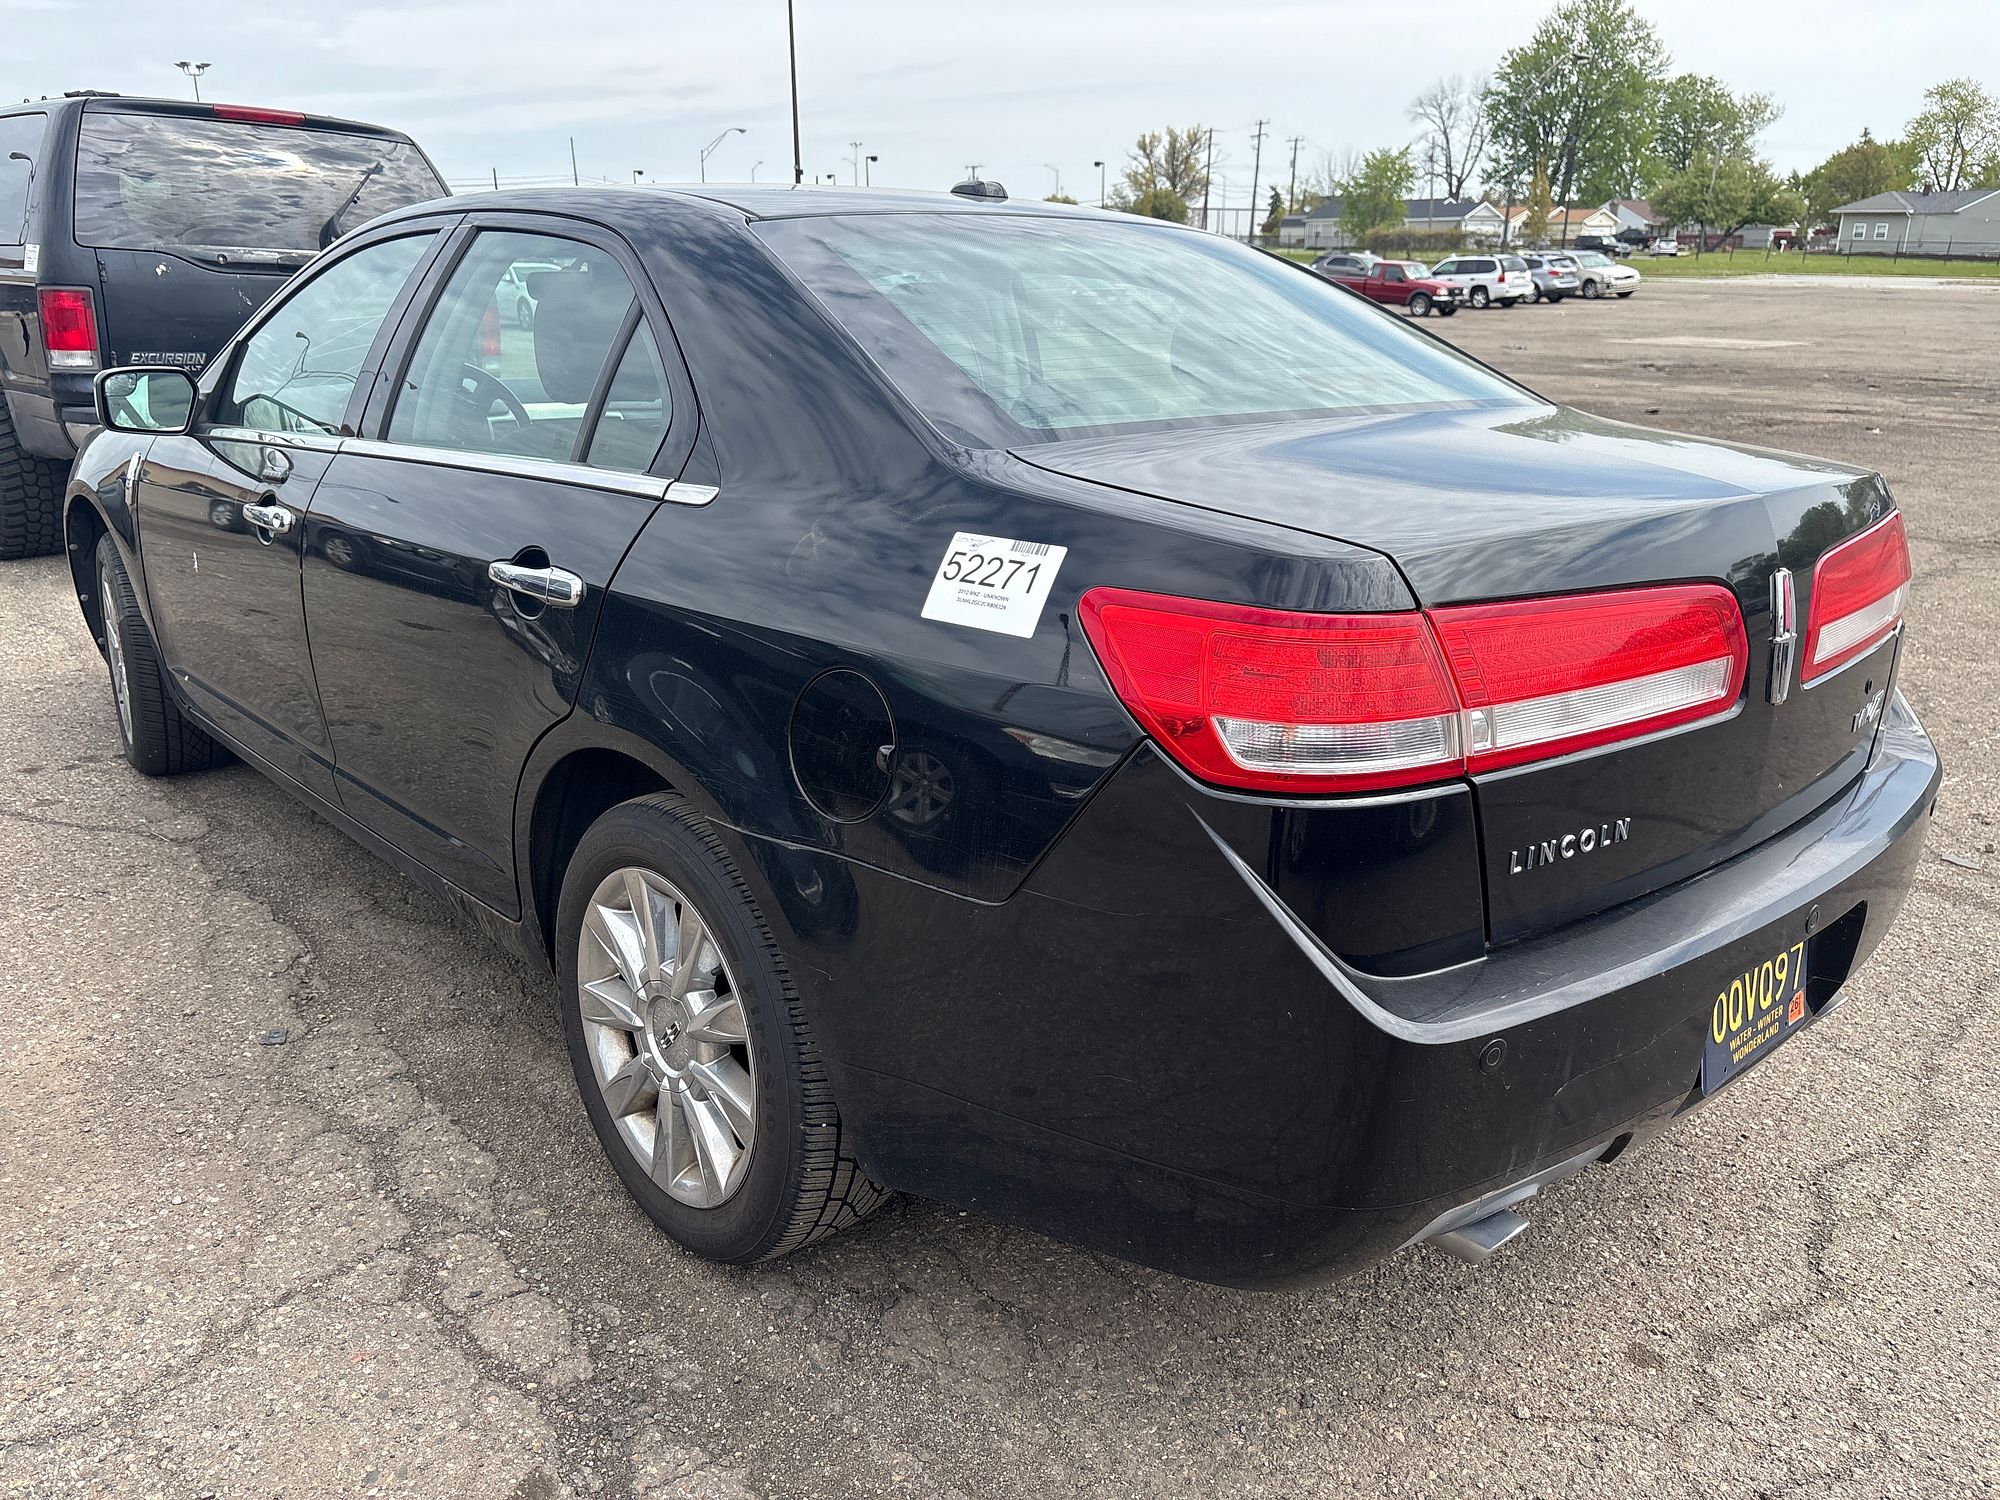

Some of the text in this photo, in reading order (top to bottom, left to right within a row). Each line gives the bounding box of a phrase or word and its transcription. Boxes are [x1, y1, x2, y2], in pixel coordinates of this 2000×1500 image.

[131, 352, 207, 365] EXCURSION
[943, 551, 1041, 594] 52271
[1508, 817, 1632, 876] LINCOLN
[1729, 1026, 1752, 1052] WATER
[1757, 1004, 1784, 1031] WINTER
[1732, 1021, 1780, 1065] WONDERLAND
